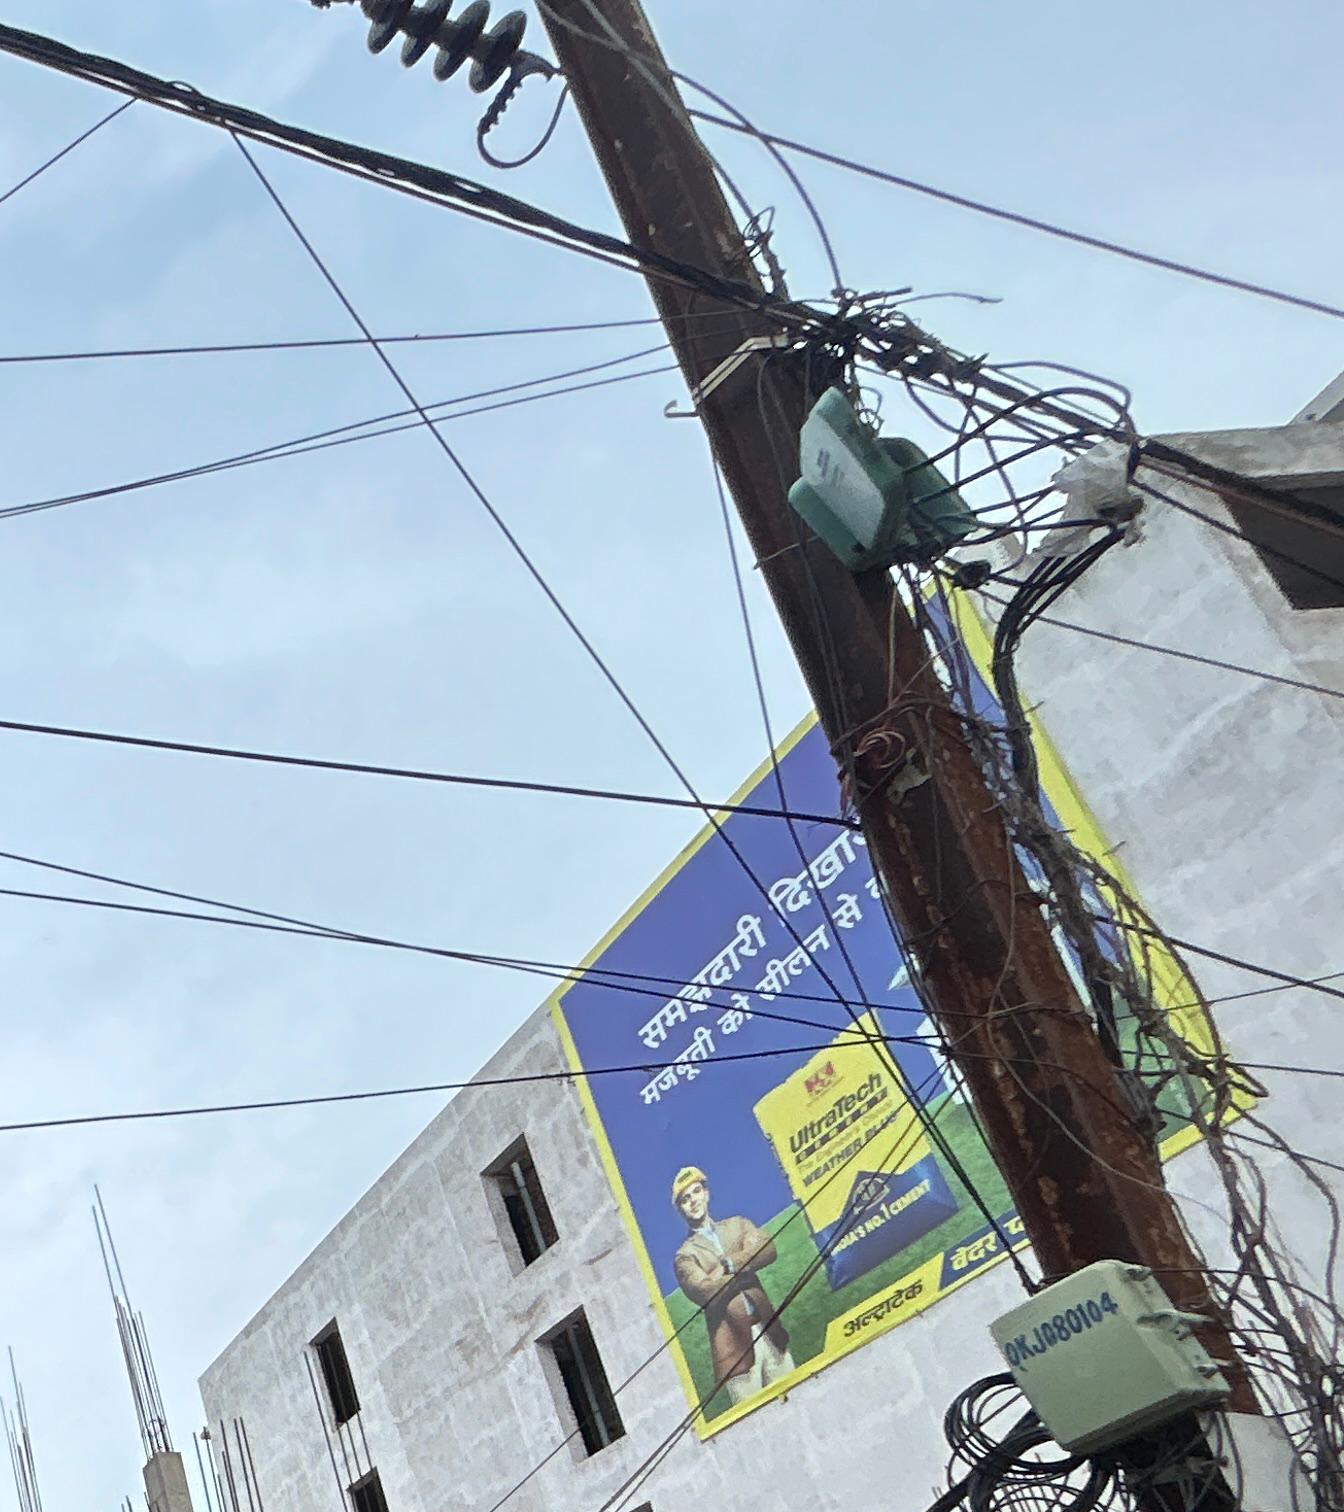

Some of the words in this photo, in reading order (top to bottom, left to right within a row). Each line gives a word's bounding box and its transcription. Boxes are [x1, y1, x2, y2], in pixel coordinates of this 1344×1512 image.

[638, 914, 767, 1049] समझदारी
[768, 814, 867, 927] दिखा
[640, 1025, 716, 1105] मजबूती
[717, 993, 754, 1036] को
[832, 893, 863, 928] से
[789, 1072, 883, 1154] UltraTech
[843, 1278, 924, 1337] अल्ट्राटेक
